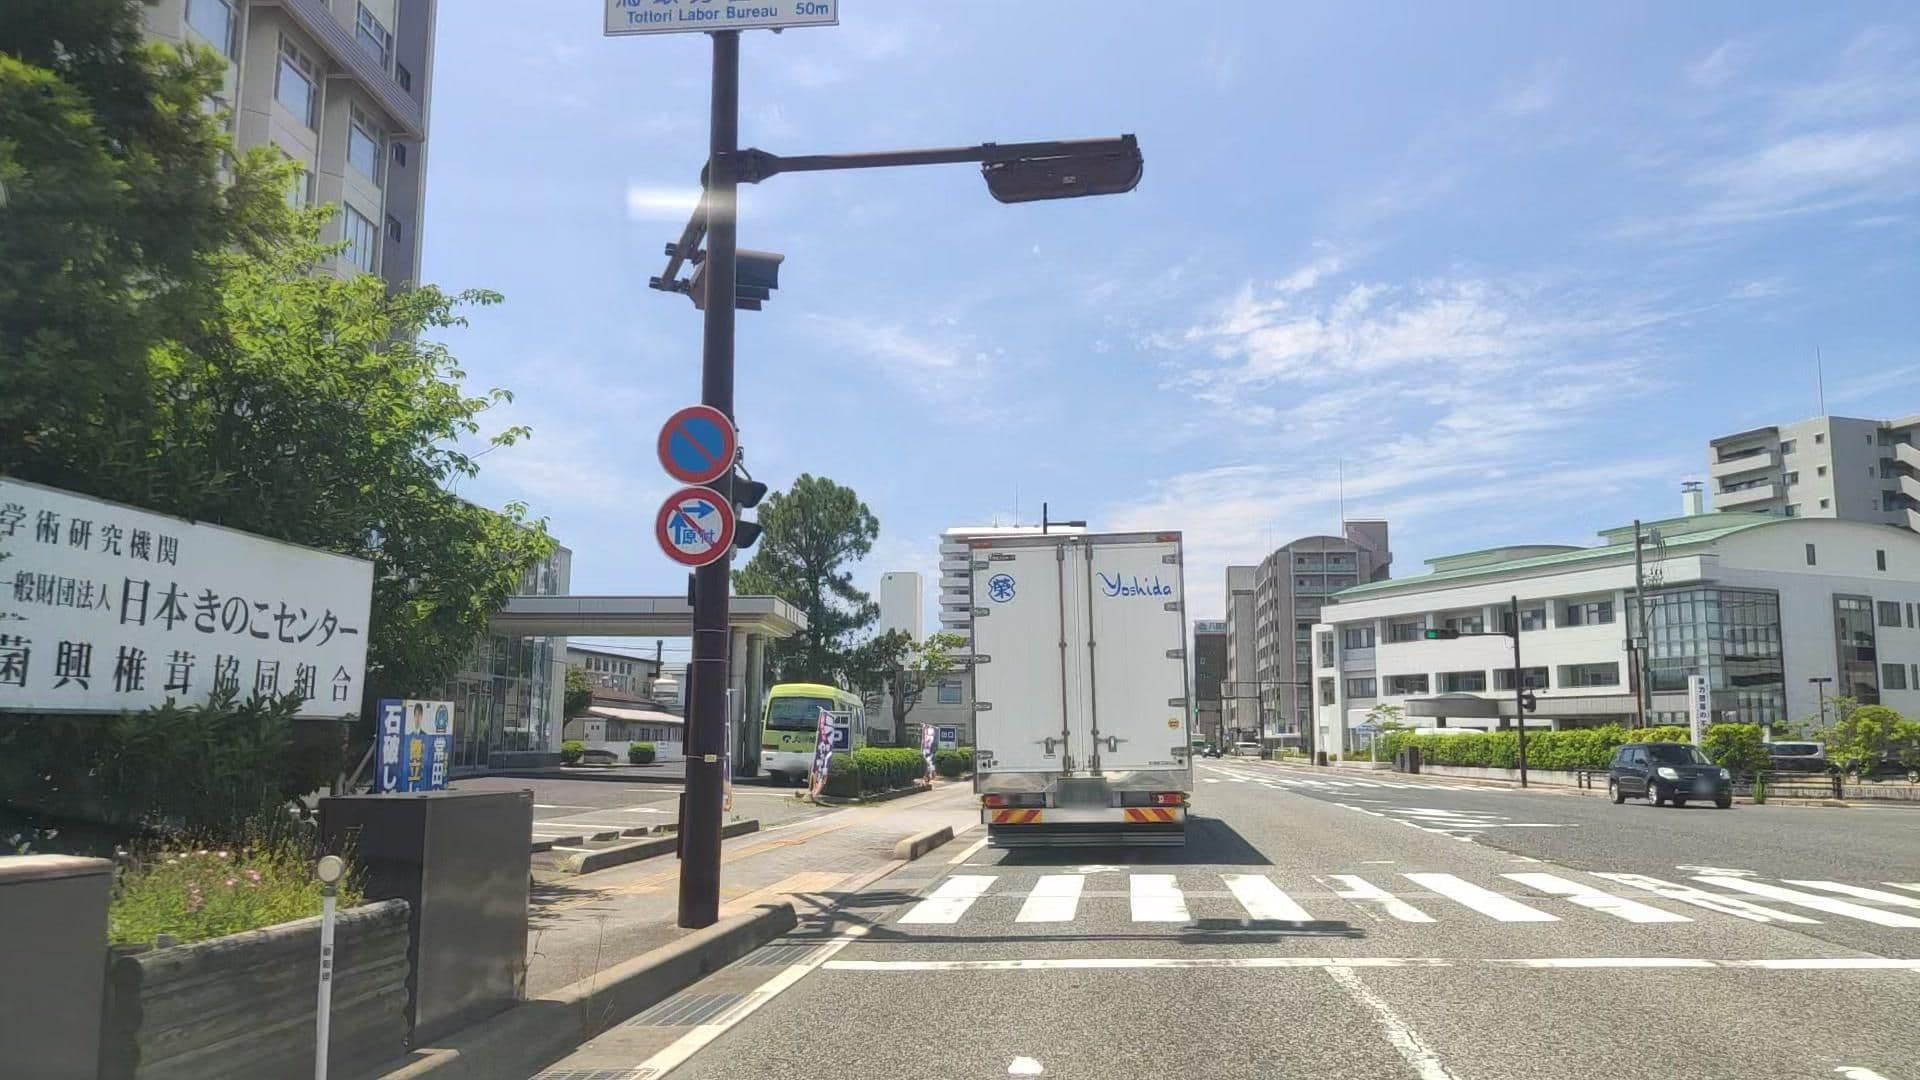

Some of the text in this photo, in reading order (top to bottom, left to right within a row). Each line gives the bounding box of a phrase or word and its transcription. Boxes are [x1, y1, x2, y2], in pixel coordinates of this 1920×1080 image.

[627, 2, 829, 24] Tottori Labor Bureau 50m
[0, 503, 179, 566] 学術研究機関
[682, 529, 716, 545] 原付
[1096, 571, 1172, 597] Yoshida
[120, 577, 358, 647] 日本きのこセンター
